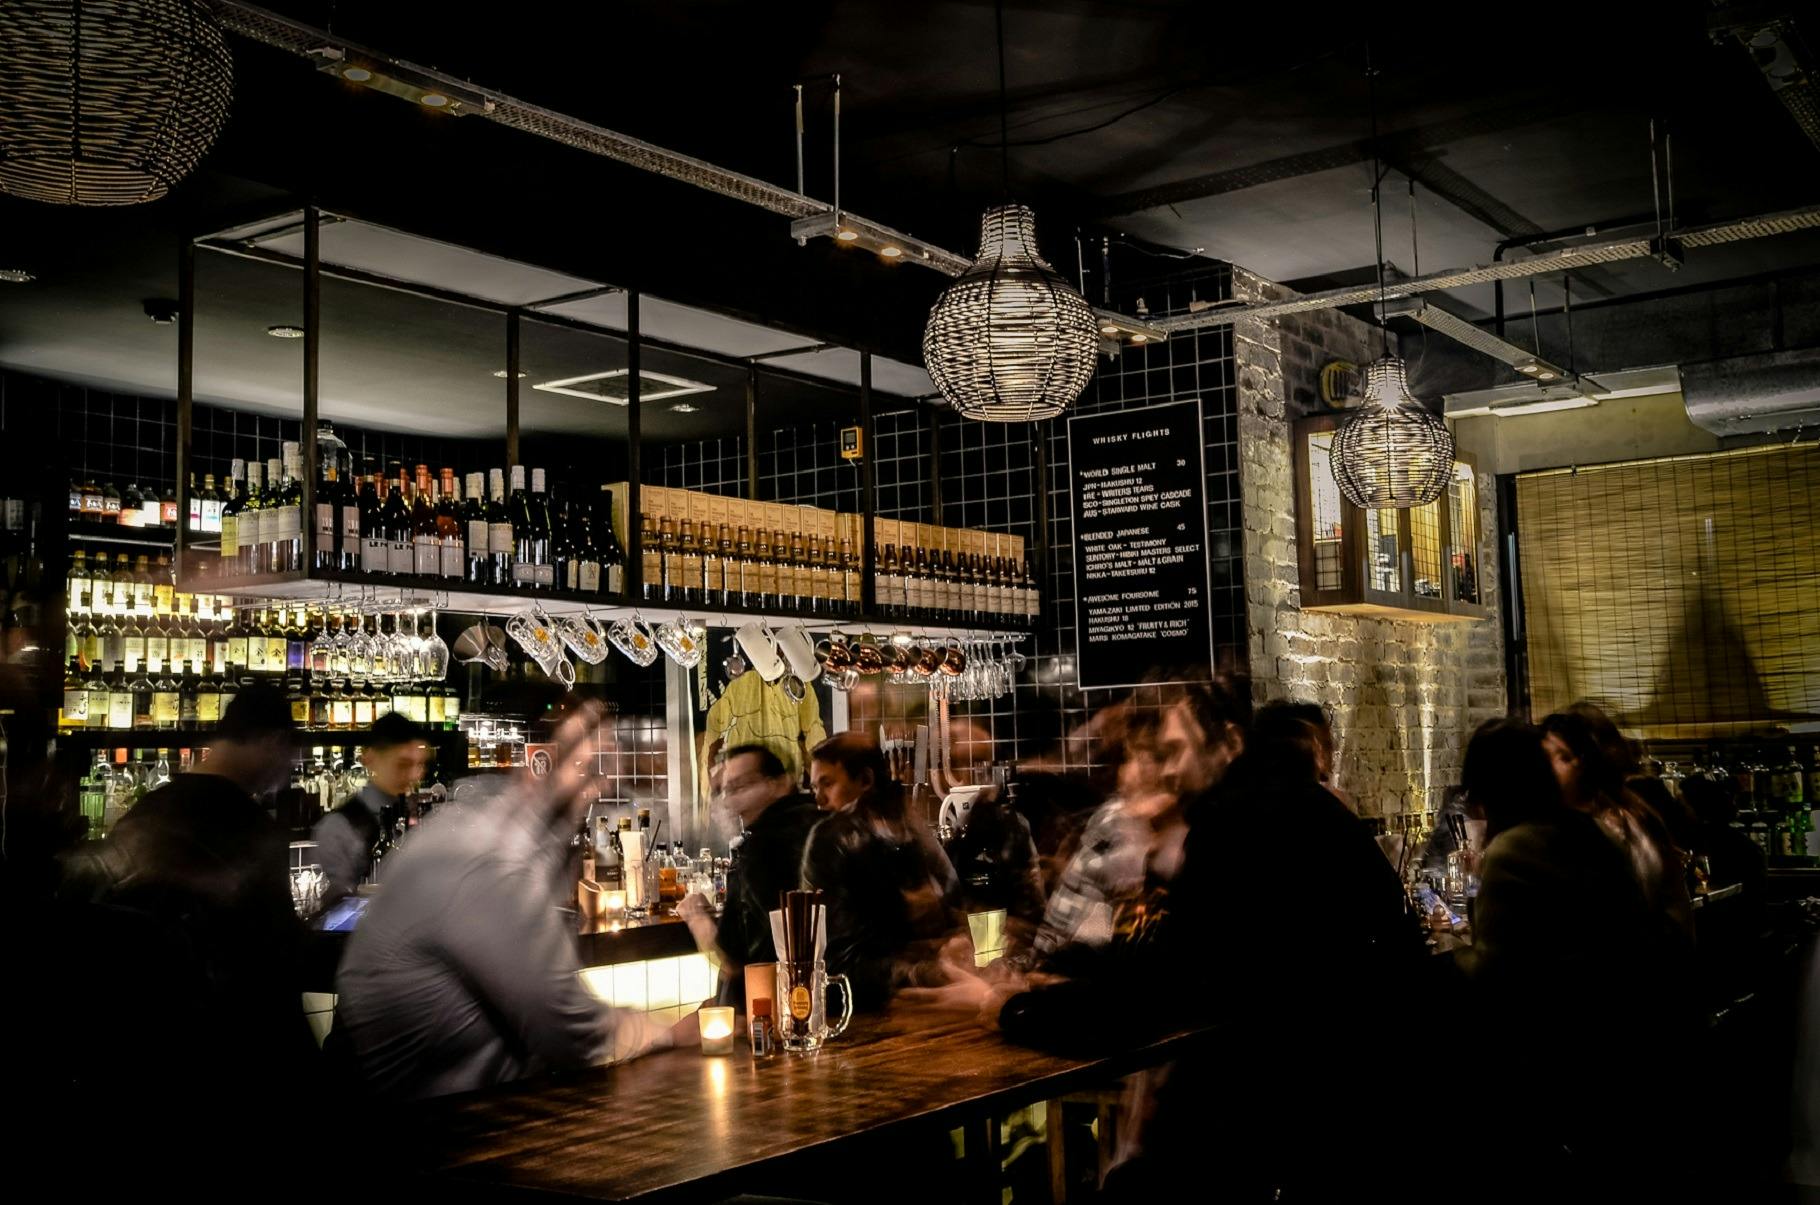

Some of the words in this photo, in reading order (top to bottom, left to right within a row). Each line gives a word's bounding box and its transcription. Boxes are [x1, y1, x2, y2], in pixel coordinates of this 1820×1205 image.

[1093, 434, 1128, 444] WHISKY
[1132, 428, 1170, 439] FLIGHTS
[1083, 468, 1109, 478] WORLD
[1111, 465, 1135, 475] SINGLE
[1138, 462, 1156, 471] MALT
[1177, 459, 1186, 467] 30
[1083, 492, 1096, 500] IRE
[1133, 484, 1154, 493] TEARS
[1141, 494, 1159, 503] SPEY
[1160, 489, 1192, 500] CASCADE
[1140, 503, 1158, 511] WINE
[1160, 500, 1181, 509] CASK
[1083, 530, 1114, 541] BLENDED
[1116, 527, 1150, 538] JAPANESE
[1177, 523, 1186, 531] 45
[1085, 544, 1105, 553] WHITE
[1108, 543, 1123, 551] OAK
[1129, 538, 1167, 549] TESTIMONY
[1140, 547, 1171, 557] MASTERS
[1174, 544, 1200, 553] SELECT
[1114, 560, 1133, 569] MALT
[1137, 557, 1156, 567] MALT
[1087, 593, 1119, 604] AWESOME
[1121, 590, 1160, 600] FOURSOME
[1188, 587, 1197, 595] 75
[1088, 607, 1123, 616] YAMAZAKI
[1125, 604, 1151, 613] LIMITED
[1153, 602, 1181, 611] EDITION
[1183, 600, 1199, 608] 2015
[1088, 615, 1120, 625] HAKUSHU
[1088, 624, 1125, 634] MIYAGIKYO
[1089, 633, 1109, 642] MARS
[1111, 631, 1157, 640] KOMAGATAKE
